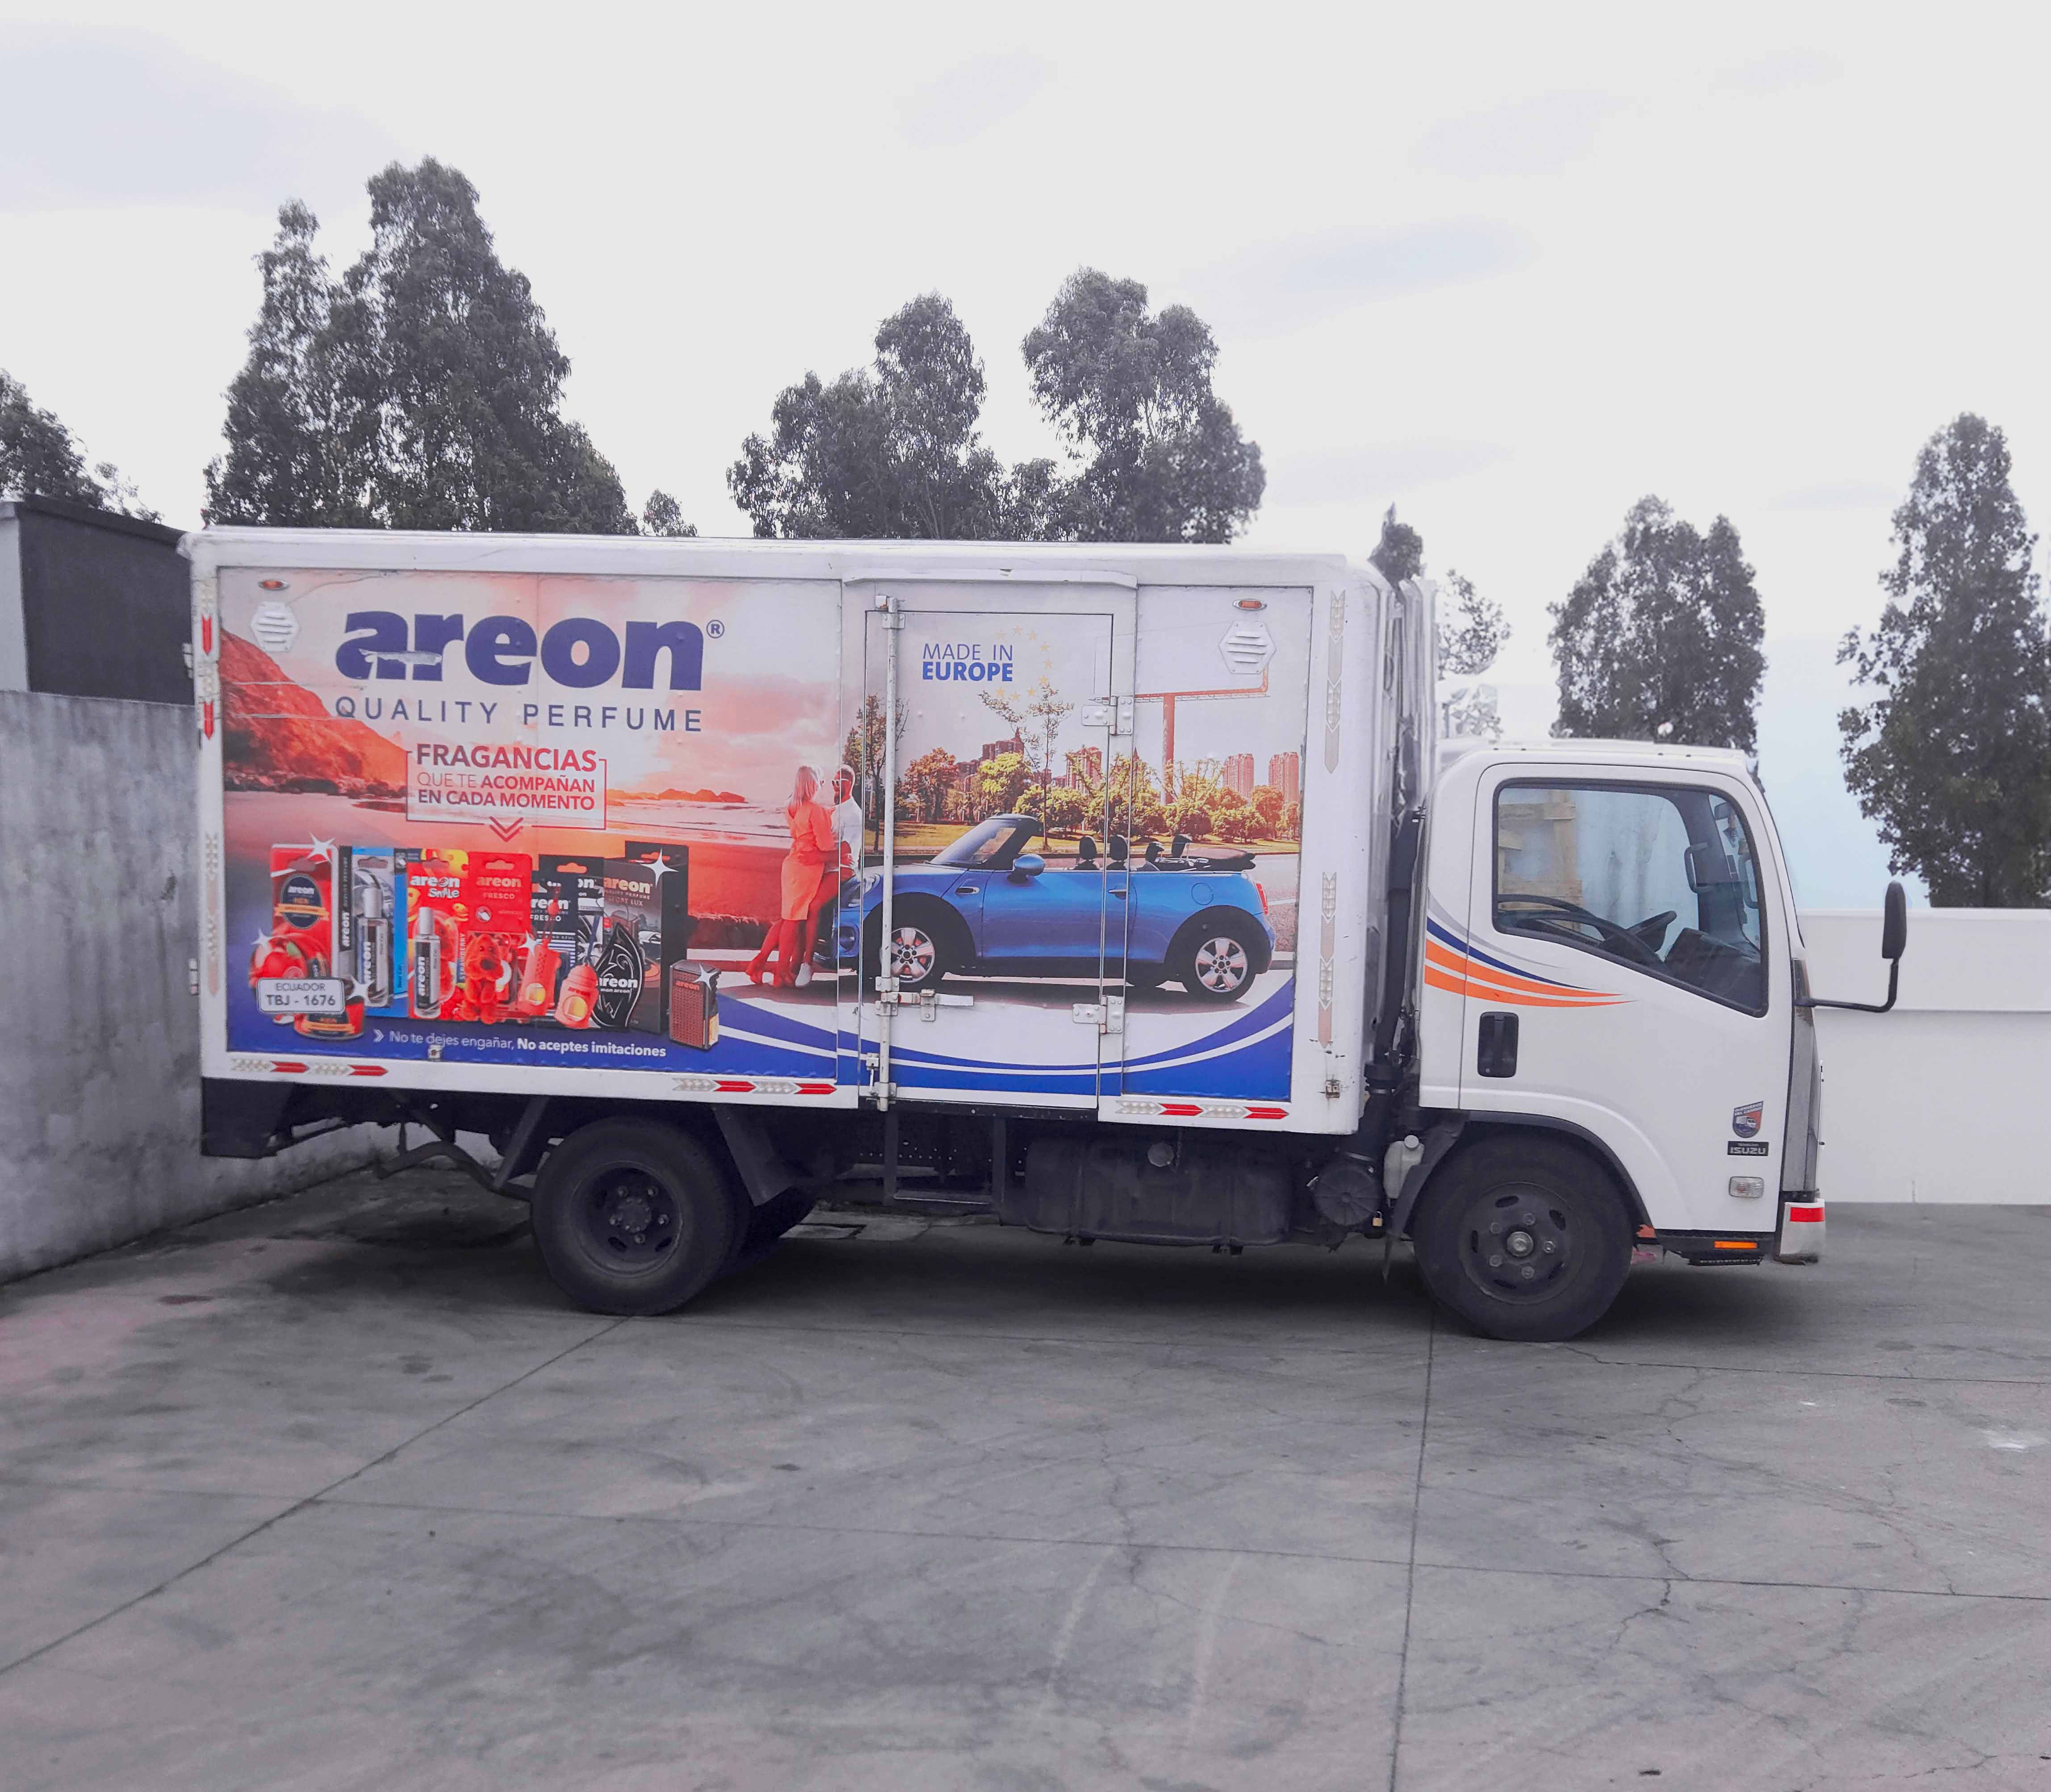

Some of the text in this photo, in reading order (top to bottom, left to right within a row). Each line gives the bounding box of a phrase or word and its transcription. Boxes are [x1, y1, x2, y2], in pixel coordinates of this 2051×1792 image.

[923, 643, 1013, 661] MADE IN
[923, 662, 1013, 682] EUROPE
[335, 696, 702, 732] QUALITY PERFUME
[416, 743, 597, 772] FRAGANCIAS
[417, 772, 595, 793] QUE TE ACOMPAÑAN
[418, 789, 595, 811] EN CADA MOMENTO
[476, 875, 522, 888] areon
[603, 877, 651, 894] areon
[342, 910, 351, 947] areon
[418, 955, 426, 996] areon
[276, 982, 326, 992] ECUADOR
[266, 994, 290, 1006] TBJ
[304, 994, 336, 1006] 1676
[389, 1030, 515, 1050] No te dejes engañar,
[517, 1038, 667, 1057] No aceptes imitaciones
[1730, 1147, 1766, 1155] ISUZU
